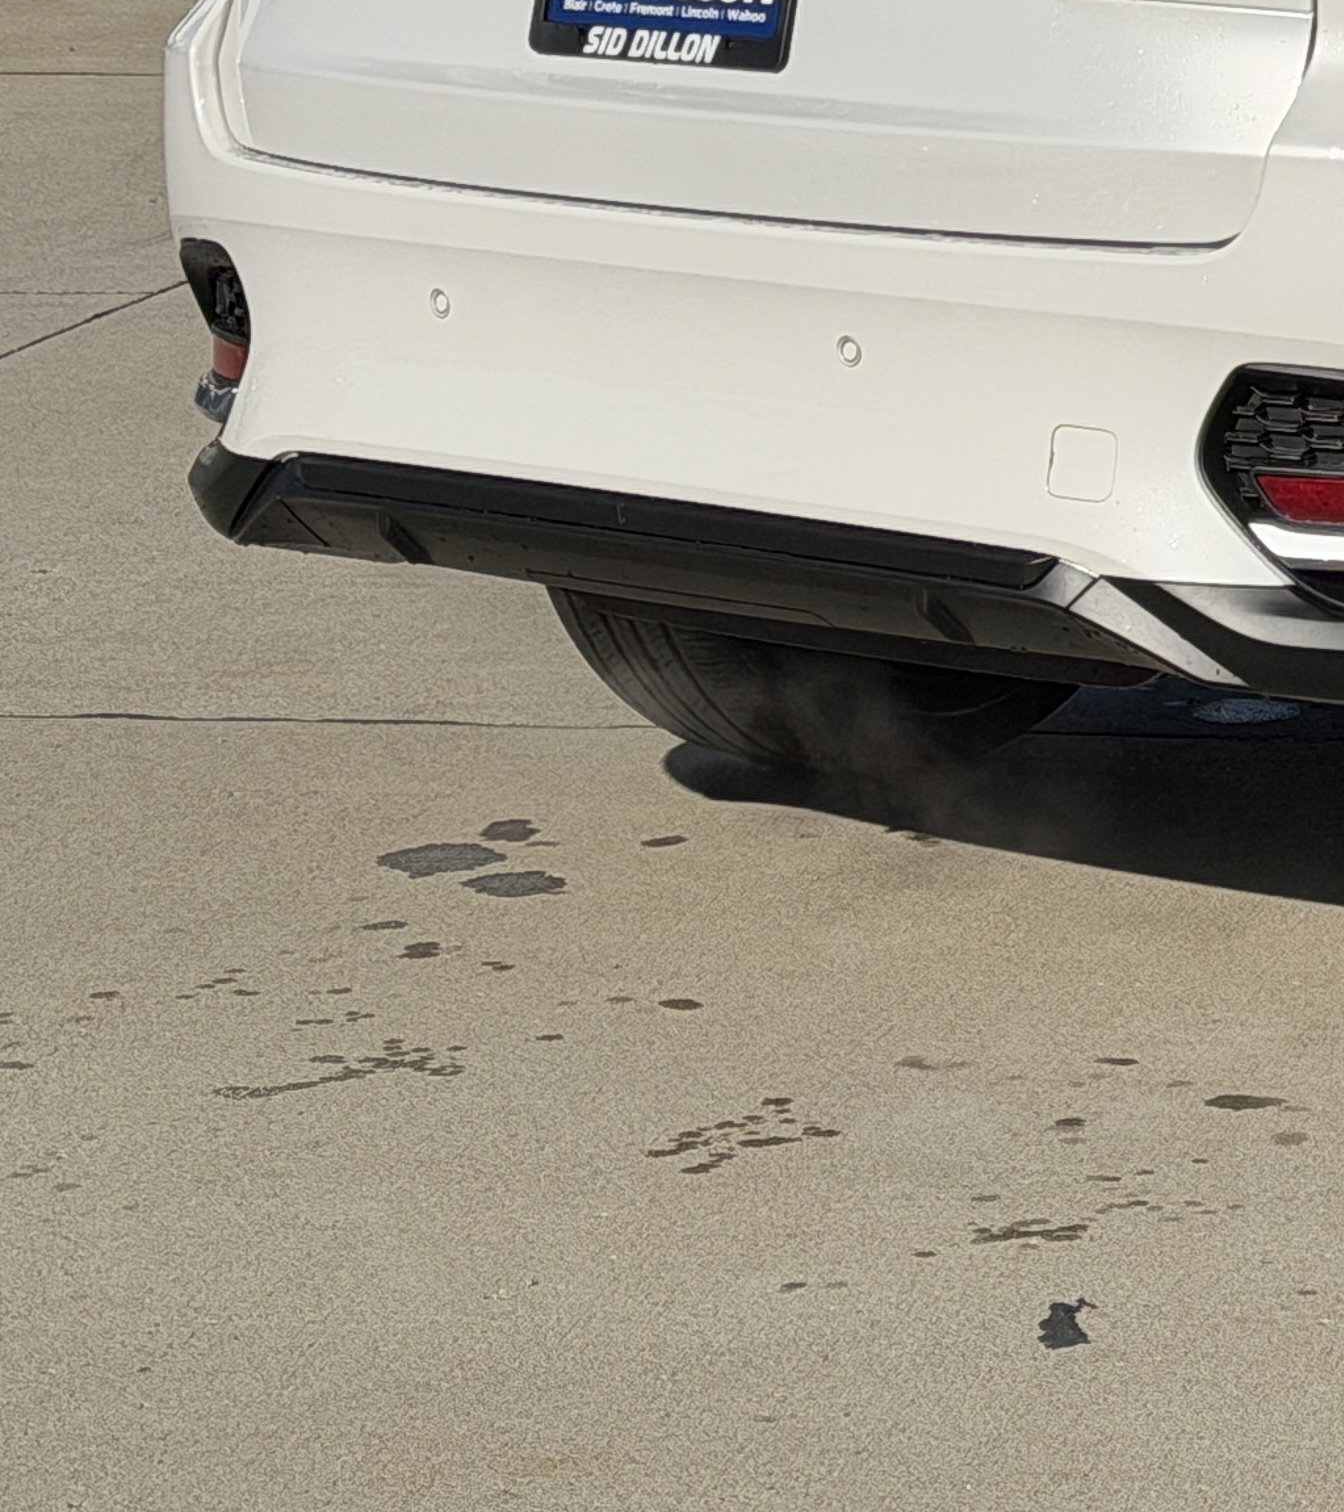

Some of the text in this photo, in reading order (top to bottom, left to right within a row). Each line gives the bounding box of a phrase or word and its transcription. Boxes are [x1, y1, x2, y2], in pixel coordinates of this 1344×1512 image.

[629, 2, 674, 18] Fremont
[681, 5, 719, 20] Lincoln
[727, 8, 766, 23] Wahoo
[582, 25, 722, 64] SID DILLON
